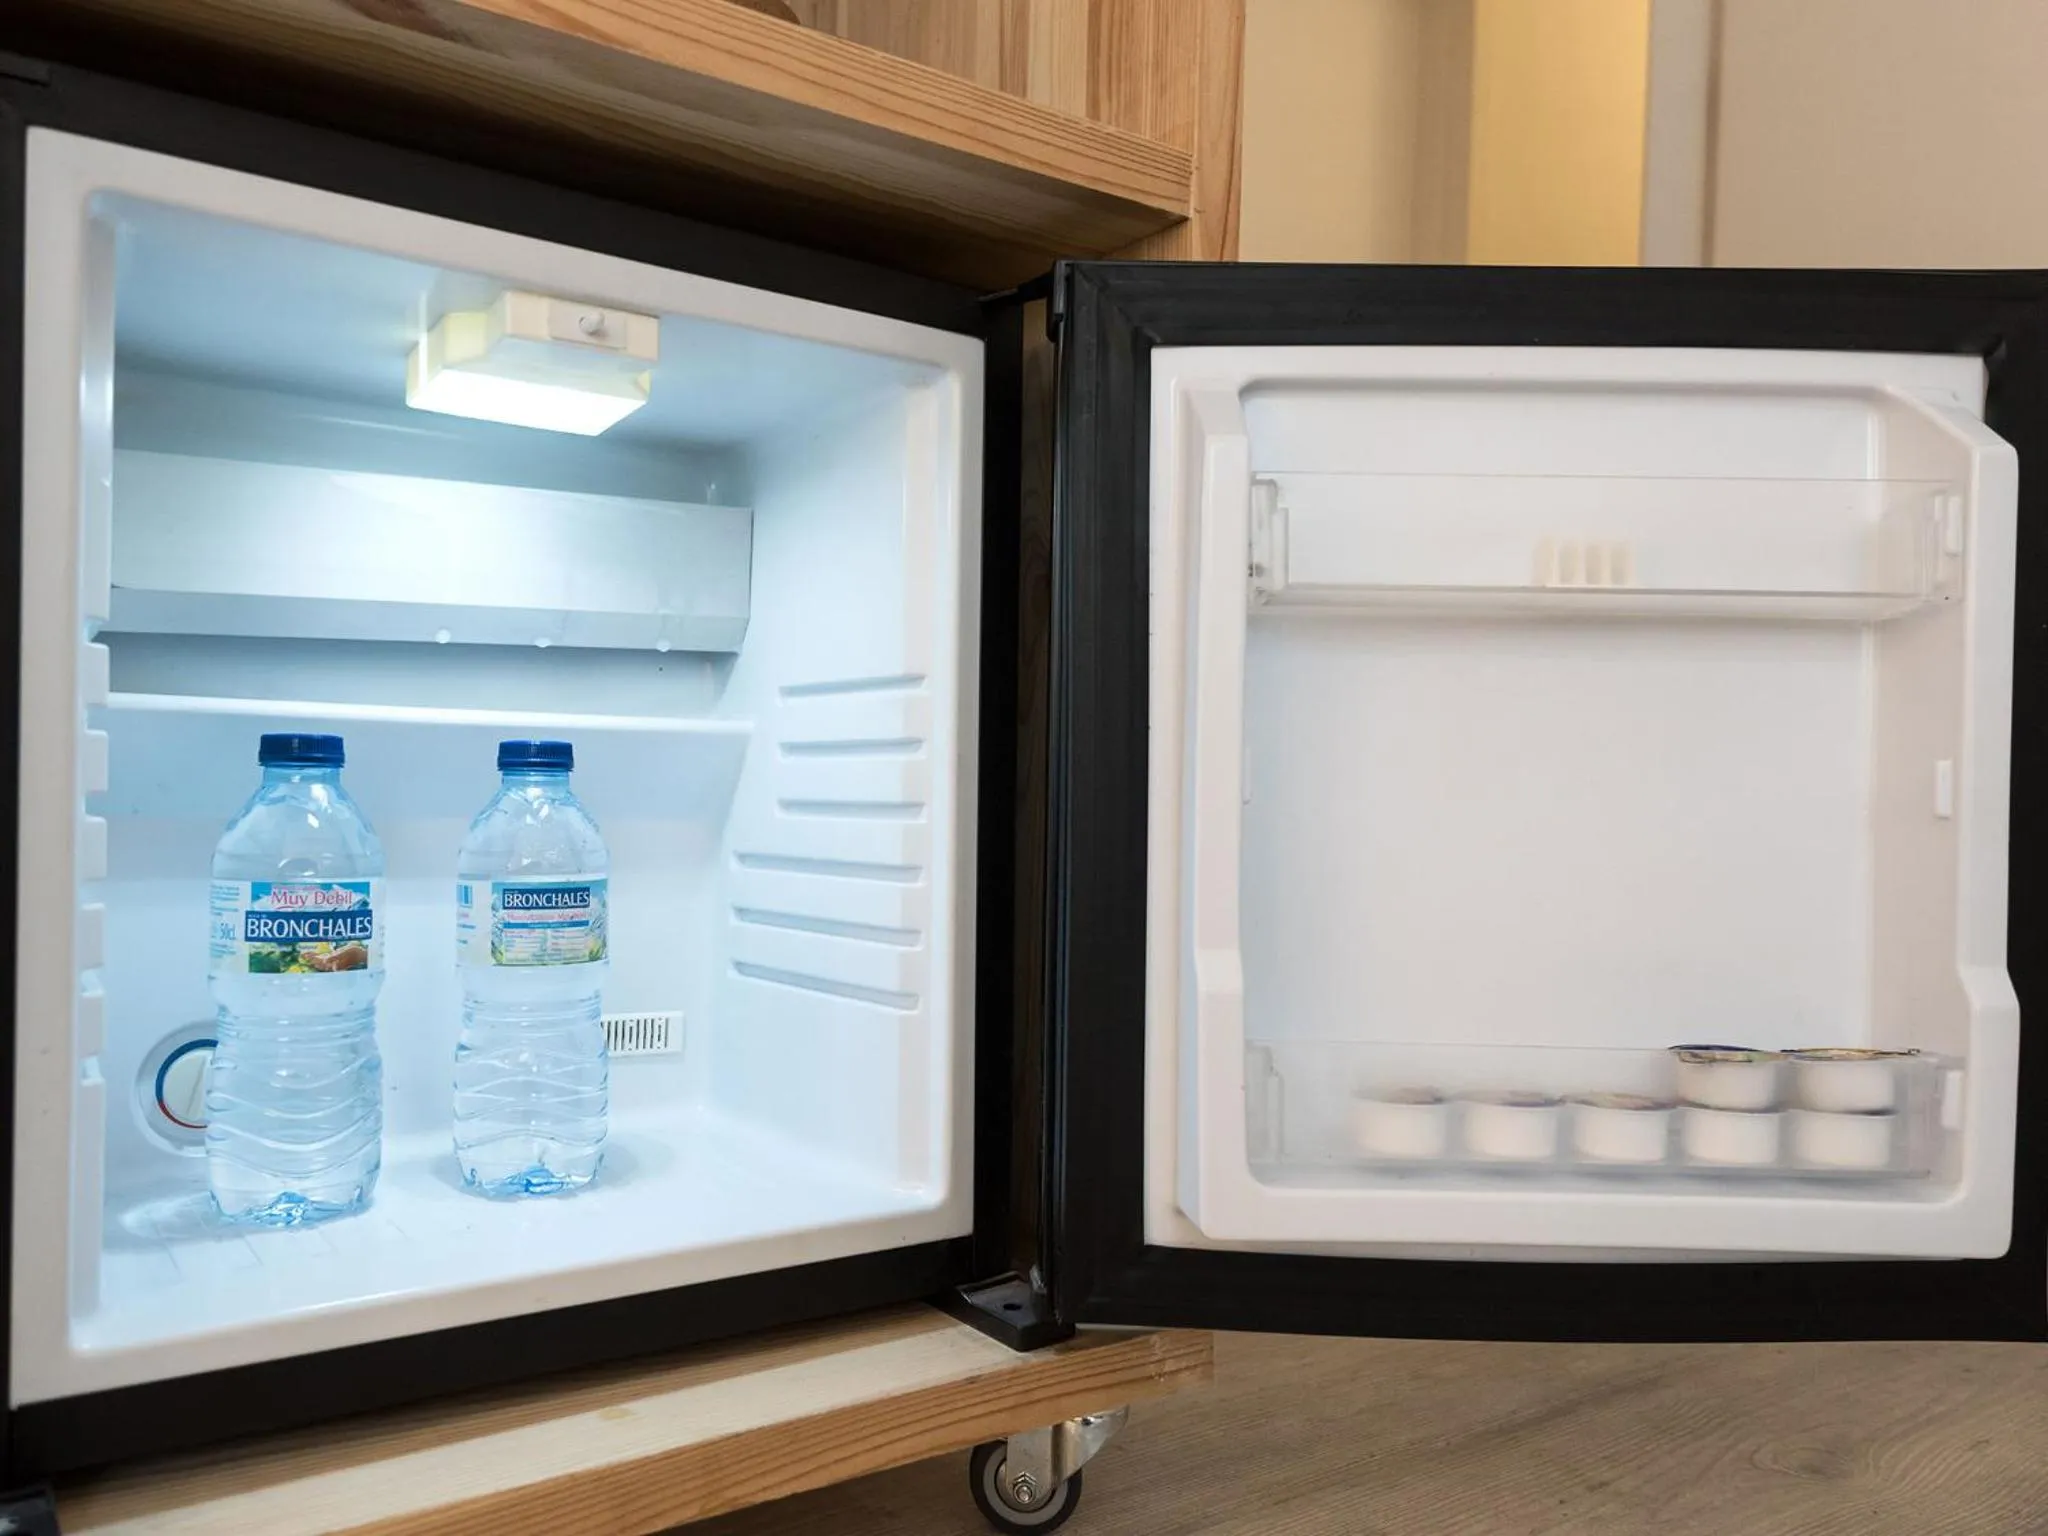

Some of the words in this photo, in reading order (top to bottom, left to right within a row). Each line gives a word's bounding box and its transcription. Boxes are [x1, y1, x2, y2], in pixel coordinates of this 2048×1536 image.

[271, 890, 309, 907] Muy
[504, 891, 590, 908] BRONCHALES
[247, 916, 372, 938] BRONCHALES
